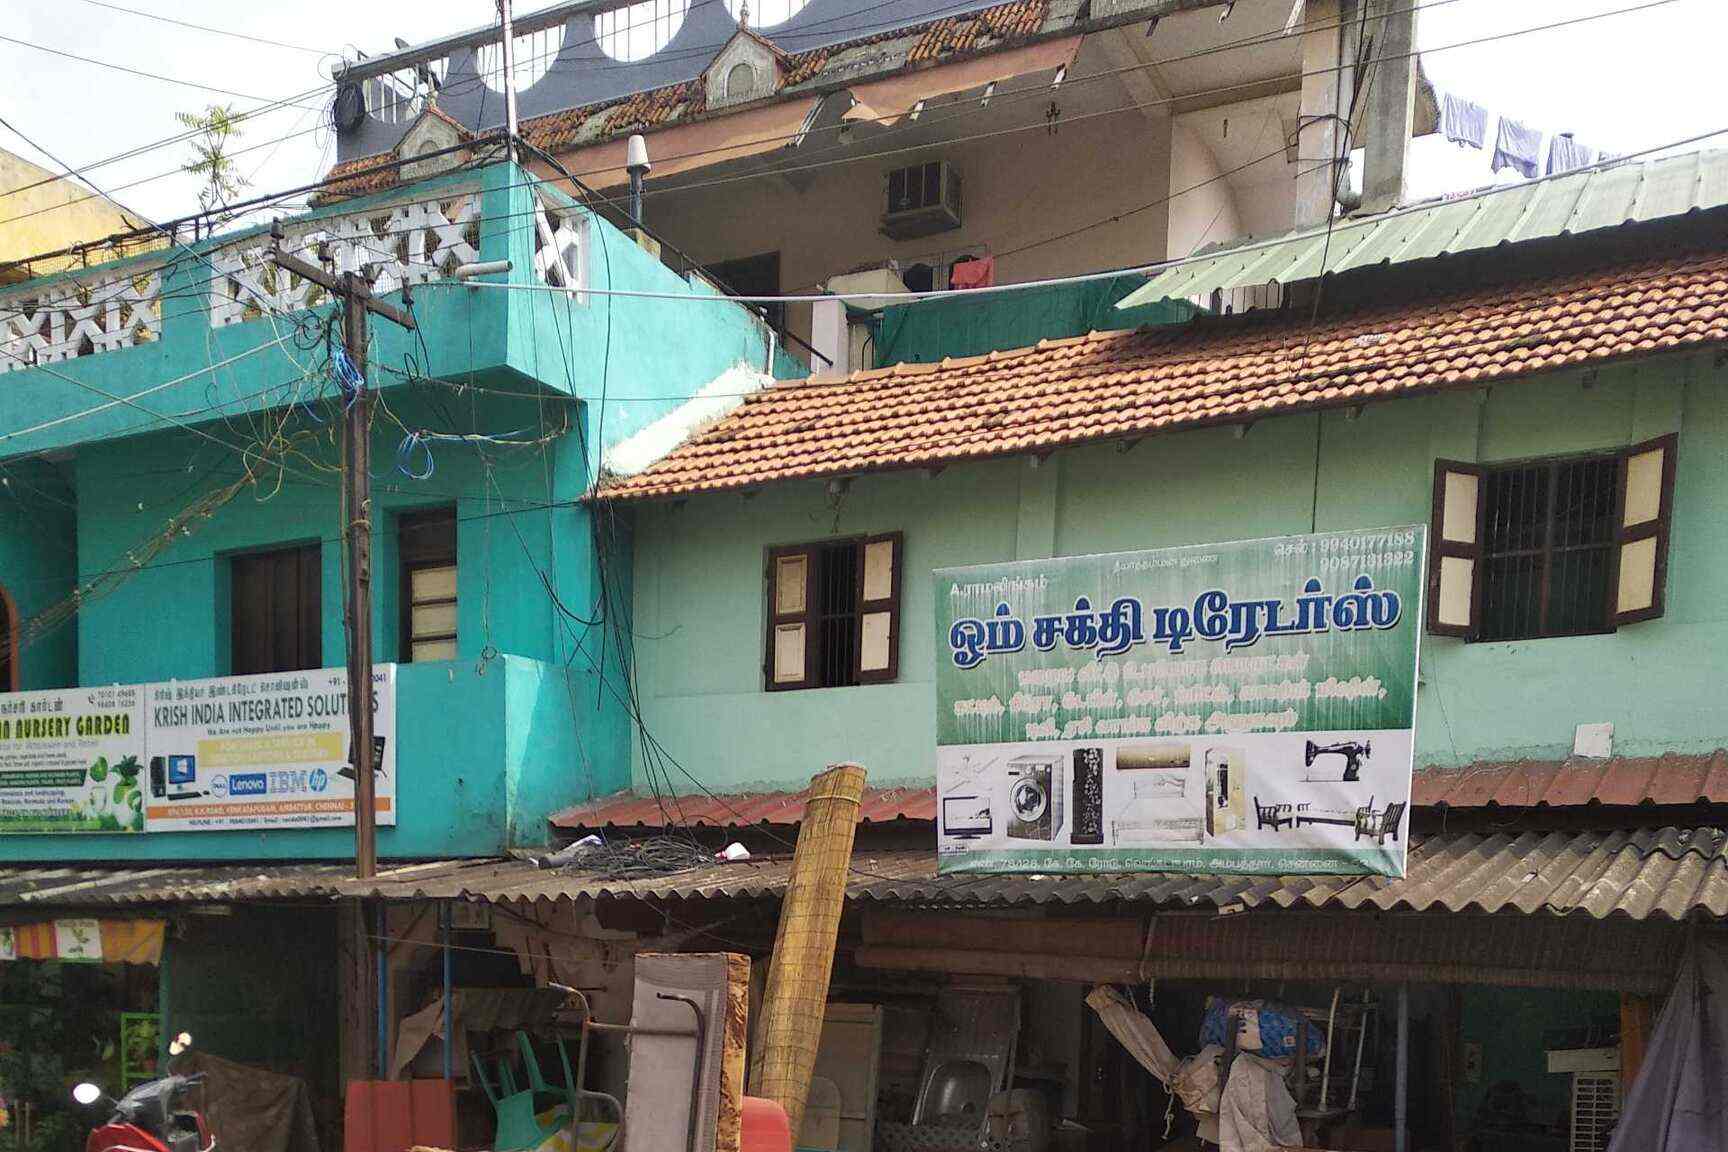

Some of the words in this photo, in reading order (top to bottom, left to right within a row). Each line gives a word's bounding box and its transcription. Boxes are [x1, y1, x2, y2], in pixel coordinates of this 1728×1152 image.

[949, 602, 1023, 668] ஓம்
[1032, 596, 1144, 661] சக்தி
[1153, 575, 1402, 652] டிரேடர்ஸ்
[154, 702, 188, 727] KRISH
[191, 700, 225, 725] INDIA
[228, 695, 303, 722] INTEGRATED
[16, 716, 71, 739] NURSERY
[76, 713, 130, 736] GARDEN
[231, 779, 265, 792] Lenovo
